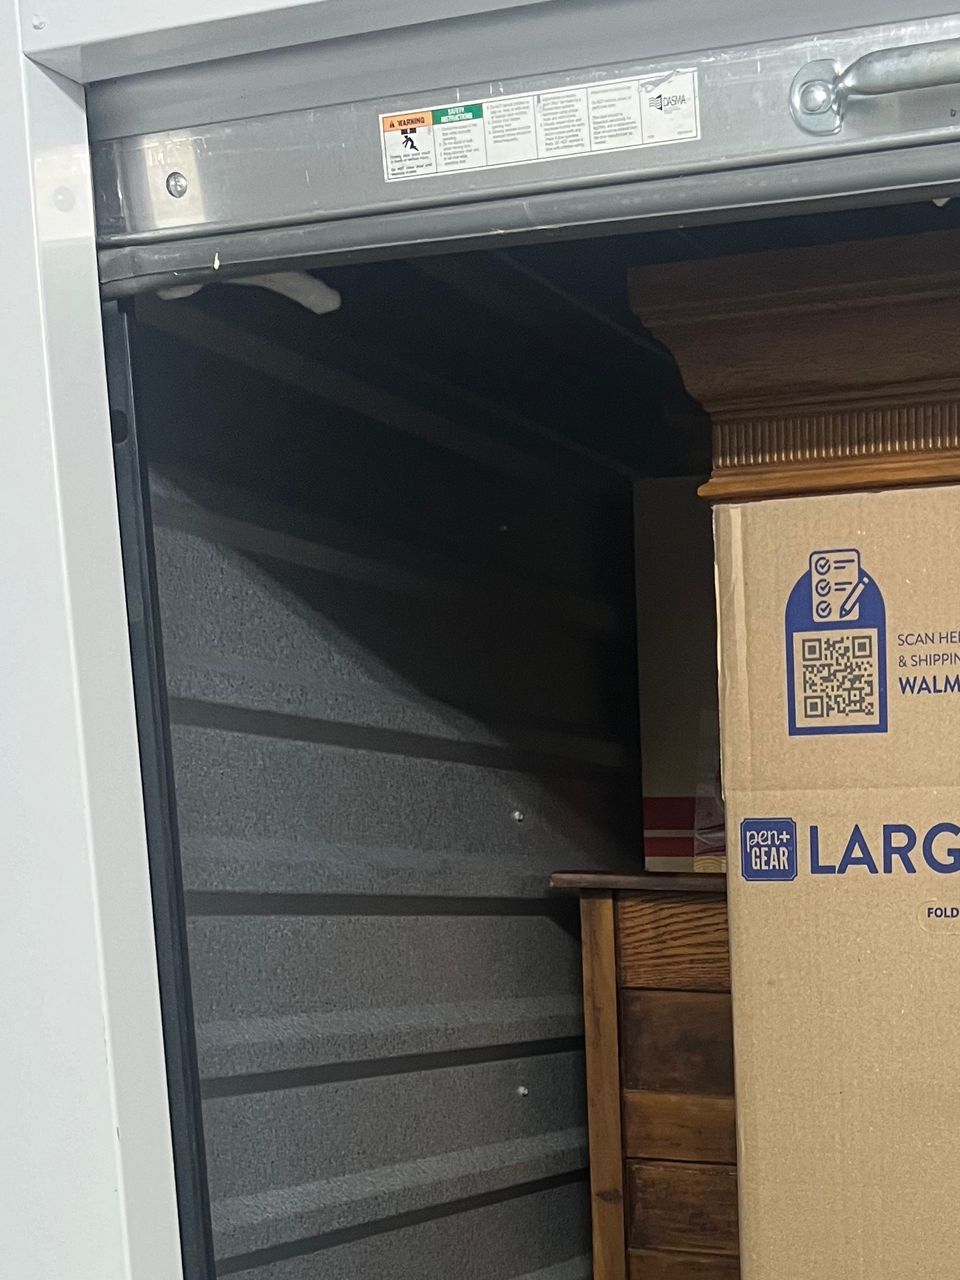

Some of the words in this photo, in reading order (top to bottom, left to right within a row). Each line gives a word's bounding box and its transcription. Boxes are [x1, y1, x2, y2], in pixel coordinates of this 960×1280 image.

[662, 94, 686, 106] DASMA
[396, 116, 425, 127] WARNING
[897, 632, 935, 647] SCAN
[898, 655, 907, 667] &
[751, 846, 789, 870] GEAR
[927, 907, 960, 918] FOLD
